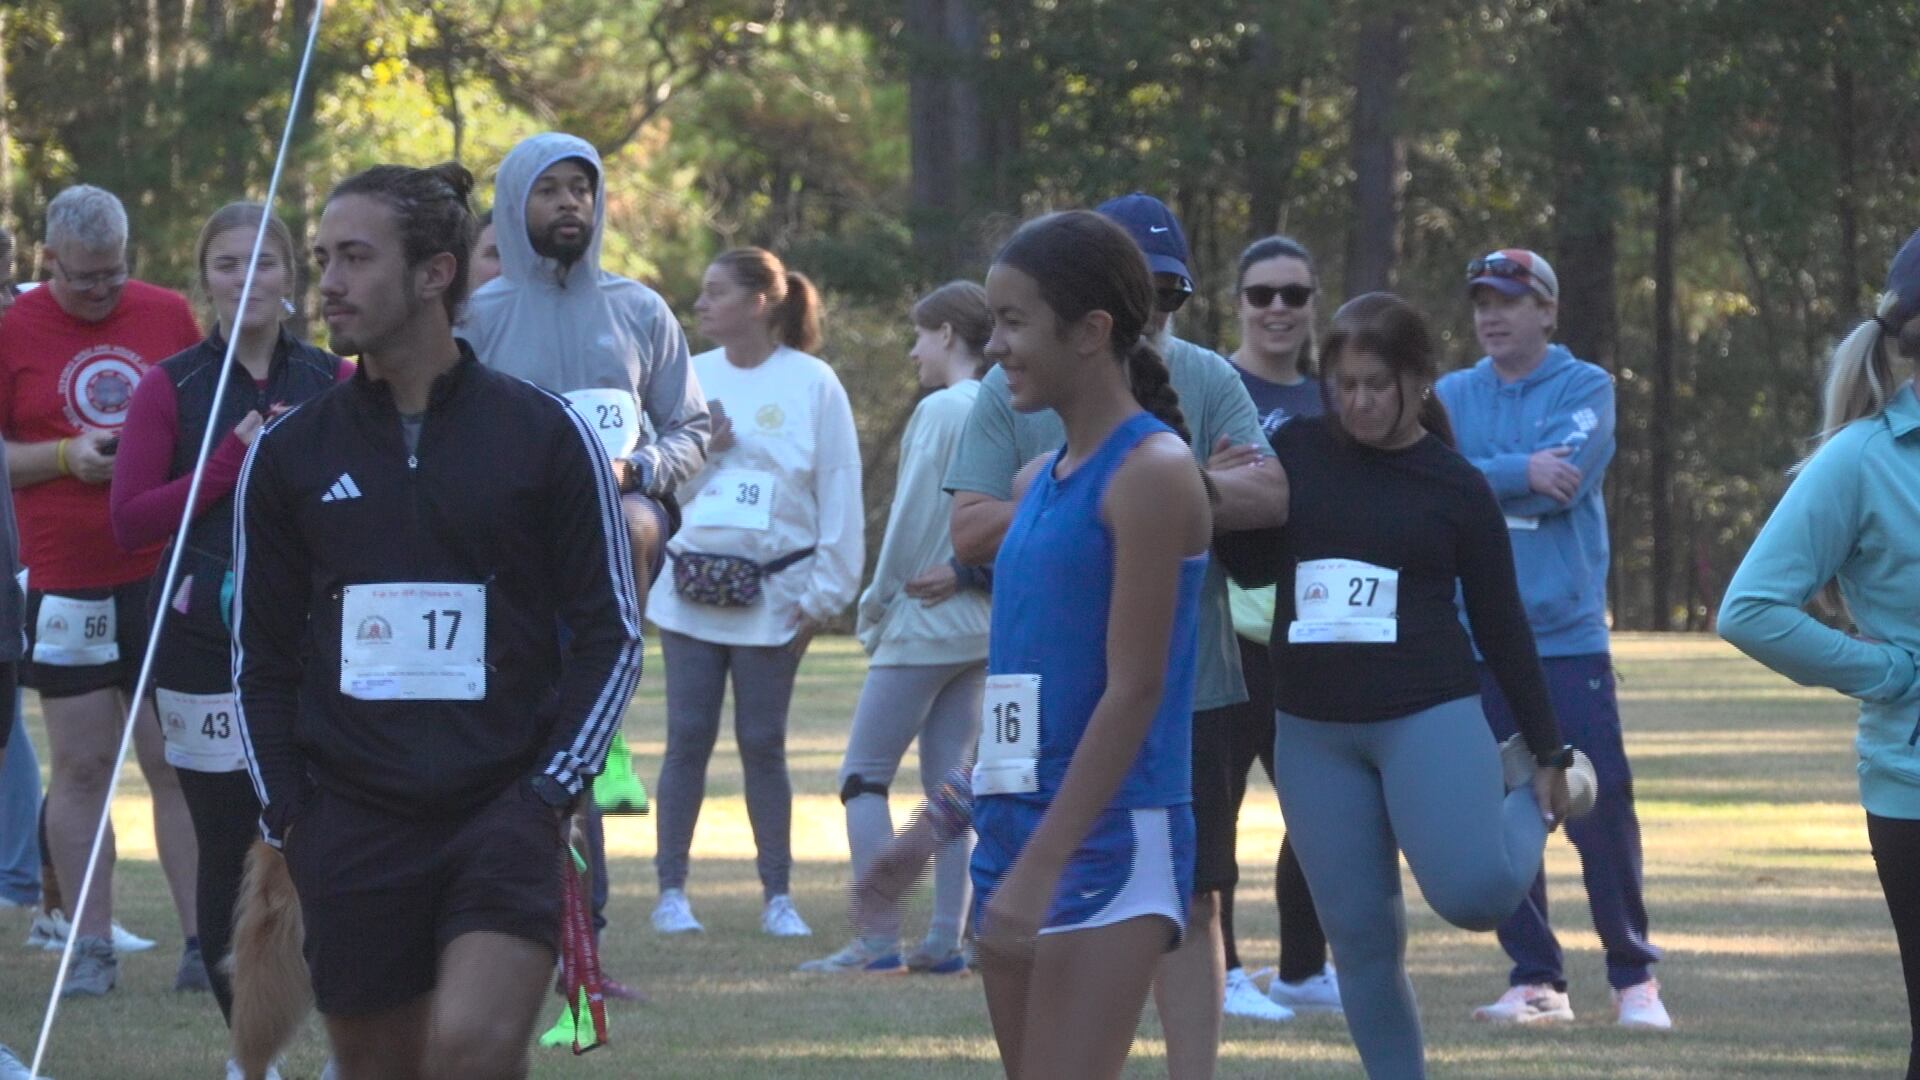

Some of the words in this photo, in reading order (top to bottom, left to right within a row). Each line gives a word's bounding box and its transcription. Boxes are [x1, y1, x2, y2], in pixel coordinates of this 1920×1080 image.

[596, 404, 623, 429] 23
[736, 482, 760, 504] 39
[1348, 577, 1379, 607] 27
[84, 615, 107, 639] 56
[421, 609, 462, 650] 17
[201, 711, 231, 739] 43
[993, 701, 1021, 743] 16
